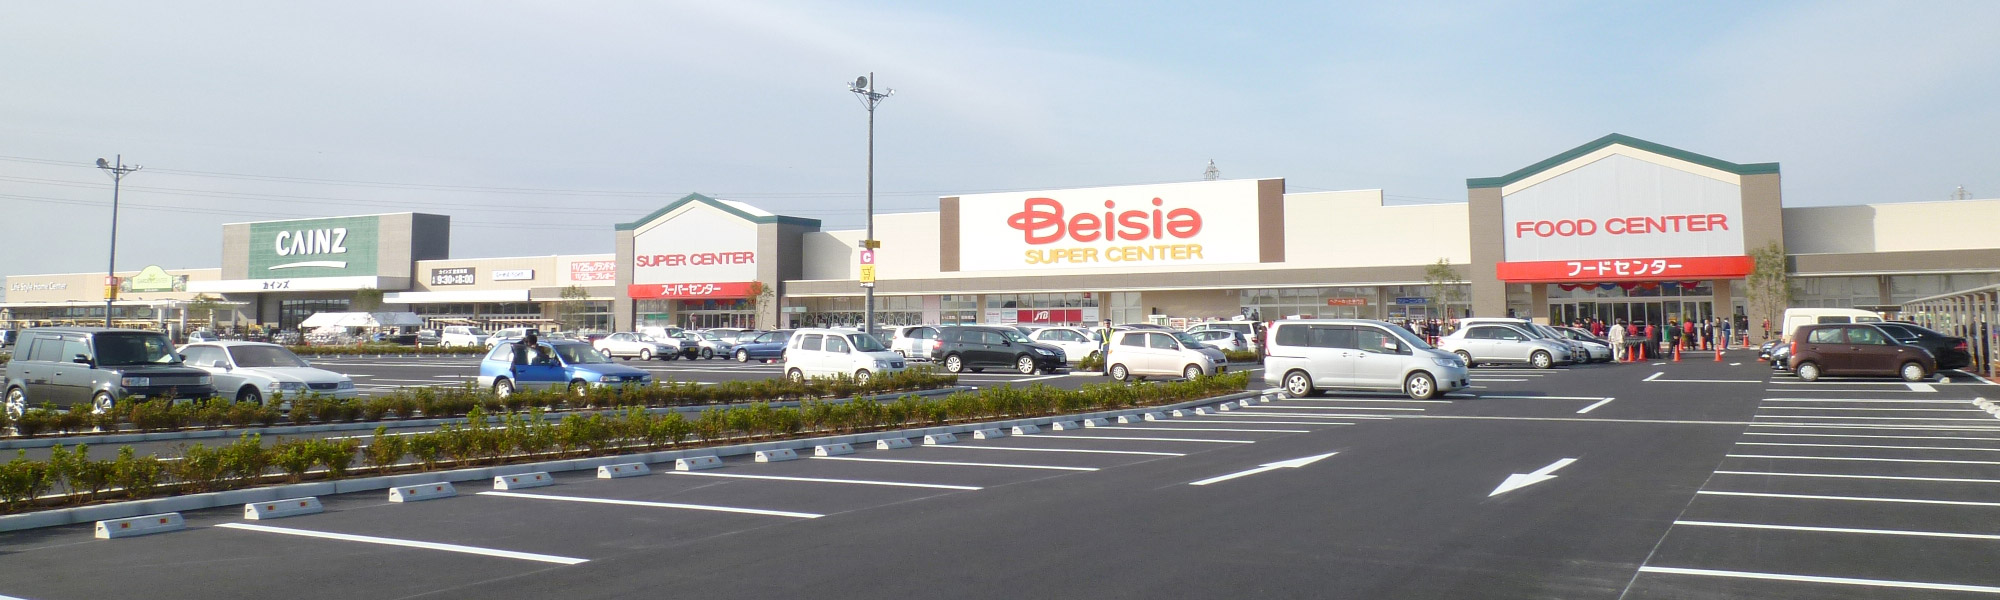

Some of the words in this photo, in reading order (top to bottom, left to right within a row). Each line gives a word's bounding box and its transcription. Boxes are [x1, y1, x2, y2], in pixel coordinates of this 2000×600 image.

[1007, 197, 1202, 245] Beisia
[1516, 218, 1597, 238] FOOD
[1605, 213, 1728, 234] CENTER
[275, 228, 347, 256] CAINZ
[637, 254, 686, 267] SUPER
[690, 252, 755, 266] CENTER
[863, 252, 871, 263] C
[1025, 248, 1099, 265] SUPER
[1105, 244, 1203, 262] CENTER
[1566, 259, 1683, 277] フードセンター
[262, 280, 290, 290] カインズ
[661, 283, 720, 295] スーパーセンター
[1034, 310, 1049, 321] JTB
